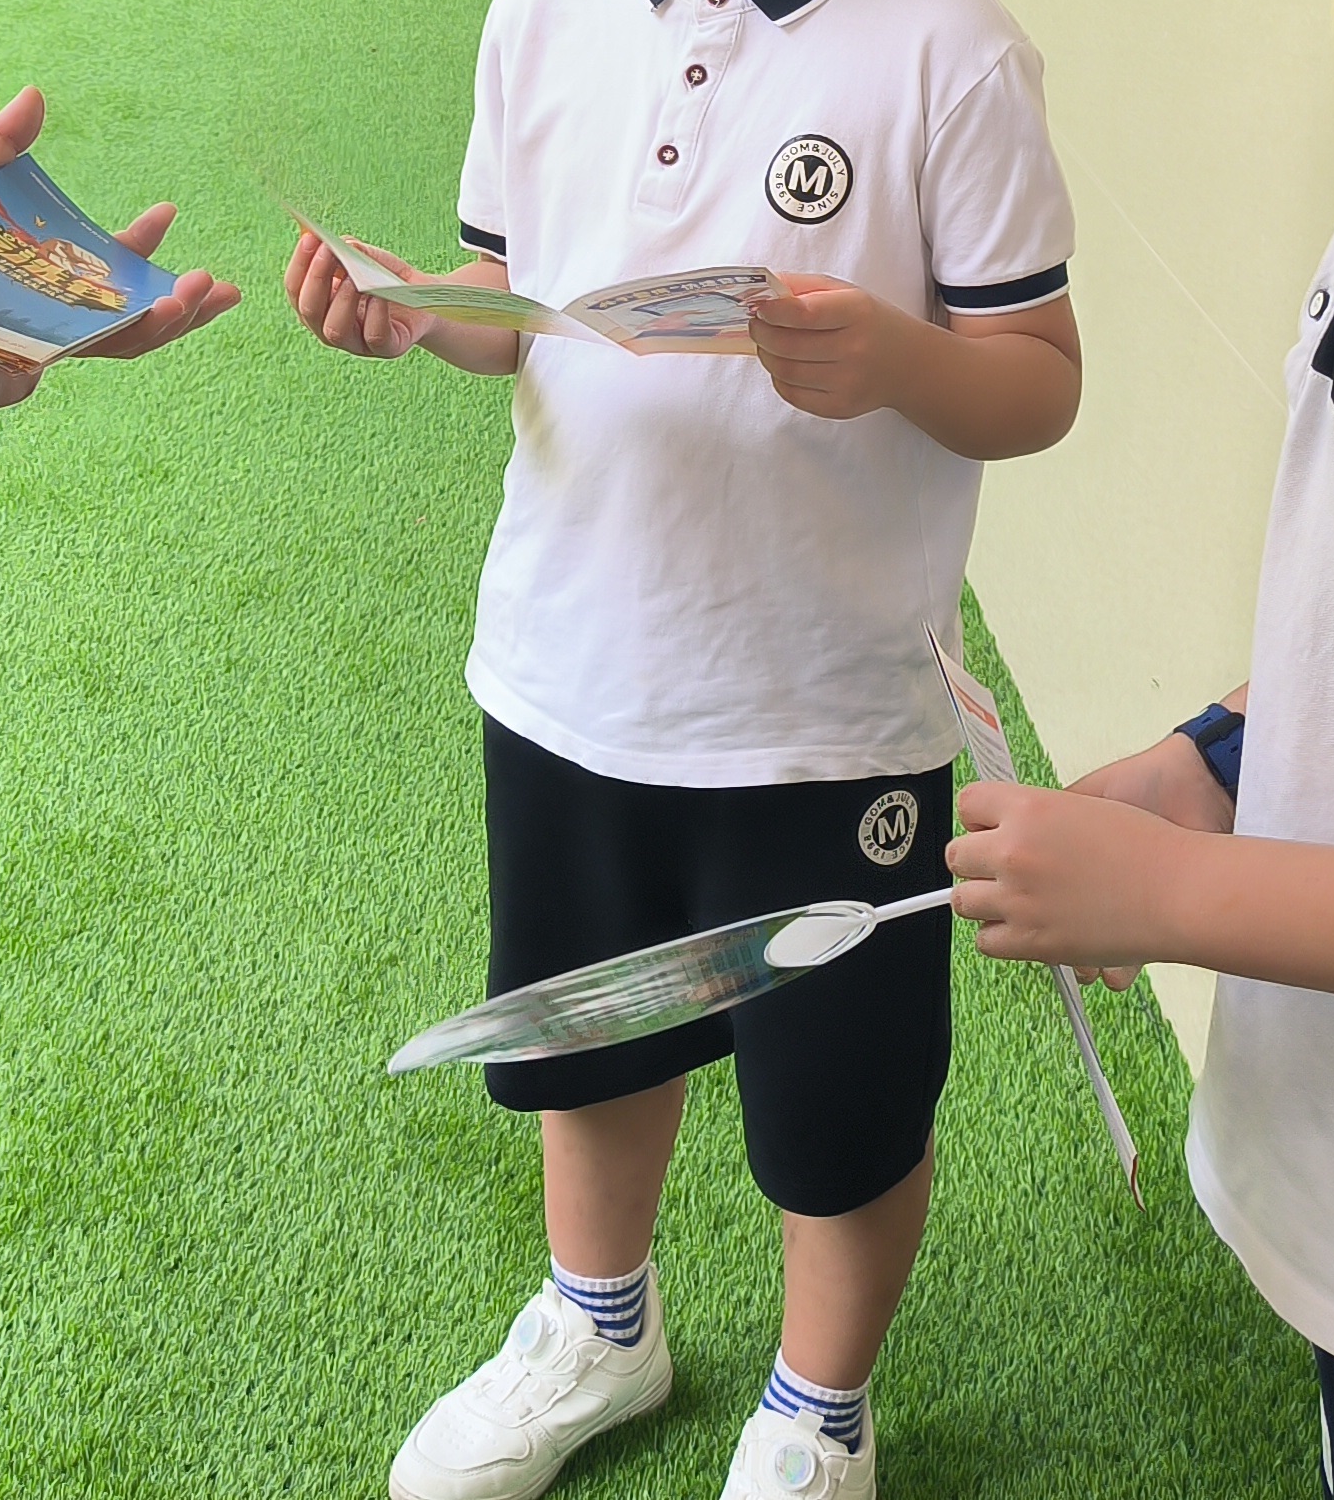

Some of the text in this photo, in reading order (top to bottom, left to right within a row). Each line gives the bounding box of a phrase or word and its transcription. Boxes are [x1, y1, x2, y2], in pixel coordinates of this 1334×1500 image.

[782, 143, 846, 177] GOM&JULY
[788, 160, 828, 196] M
[797, 190, 839, 213] SINCE
[878, 808, 906, 845] M
